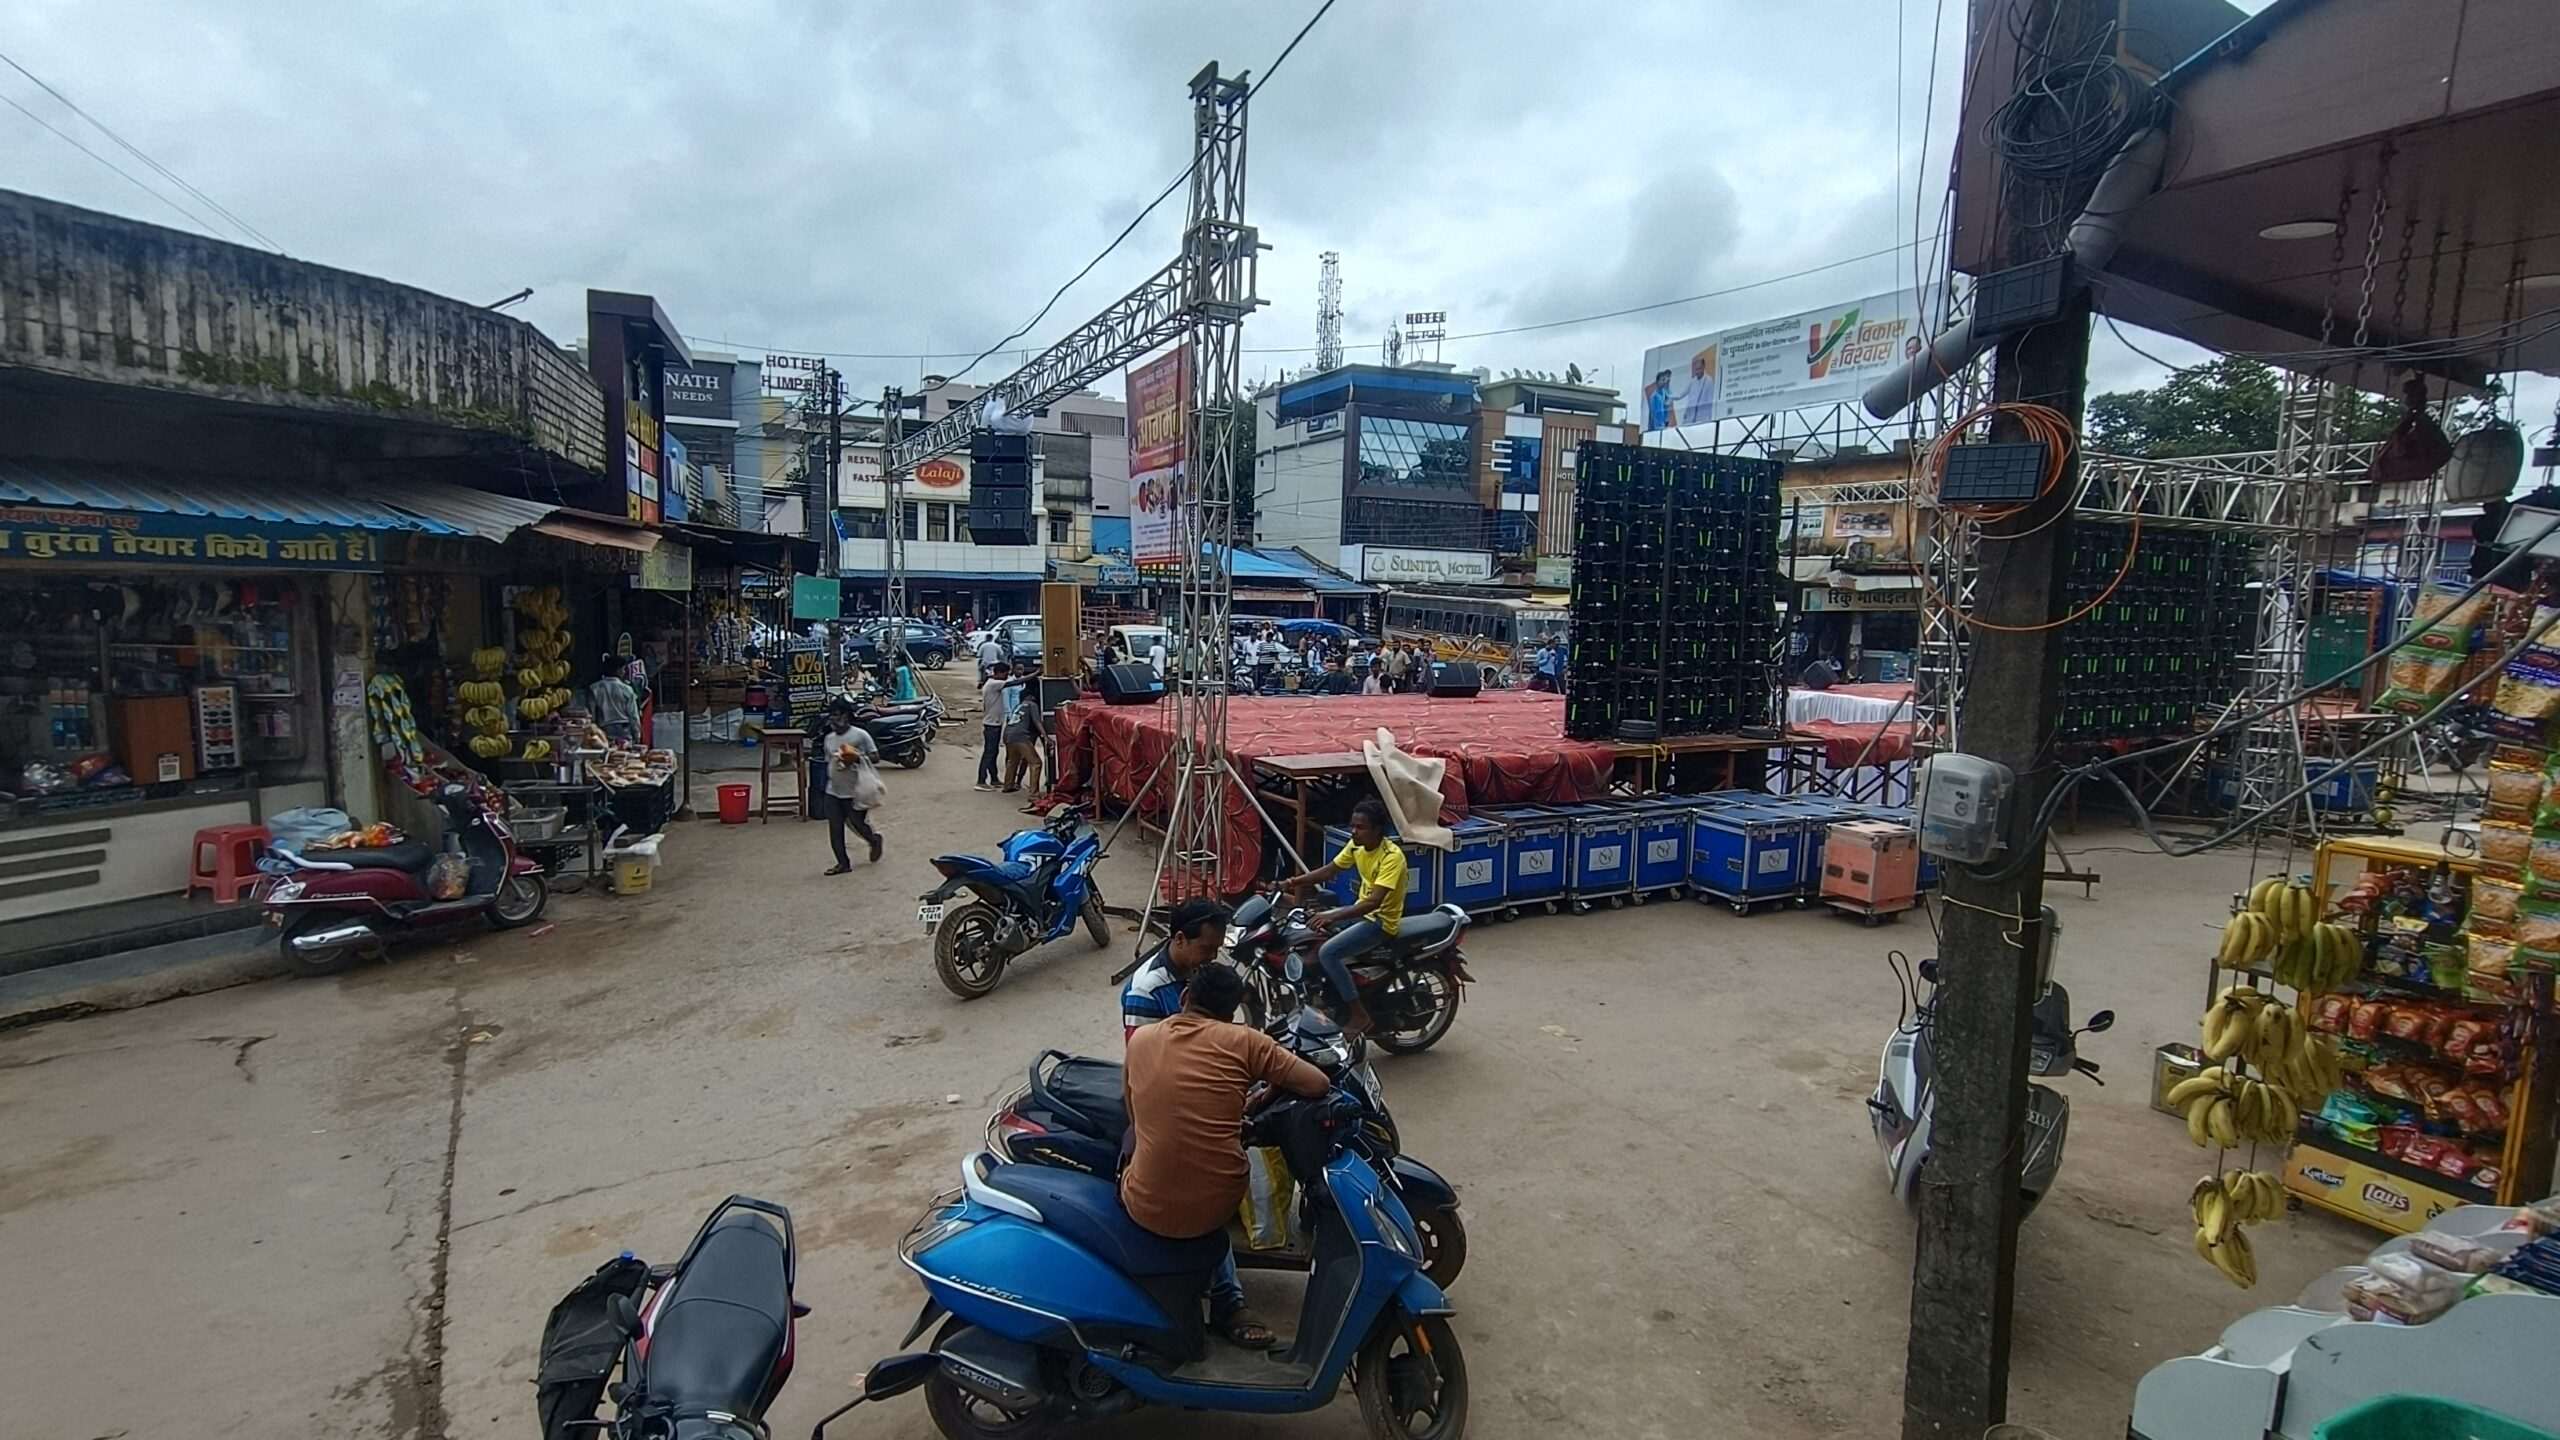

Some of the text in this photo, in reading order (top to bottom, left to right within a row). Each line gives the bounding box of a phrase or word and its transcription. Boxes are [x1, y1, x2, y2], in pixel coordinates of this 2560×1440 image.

[1406, 312, 1446, 324] HOTEL
[1856, 319, 1908, 344] विकास
[766, 354, 822, 371] HOTEL
[1839, 342, 1894, 368] विश्वास
[665, 372, 720, 390] NATH
[672, 391, 713, 402] NEEDS
[920, 467, 961, 480] Lalaji
[22, 527, 102, 557] तुरंत
[108, 529, 198, 556] तैयार
[205, 533, 271, 559] किये
[277, 533, 338, 561] जाते
